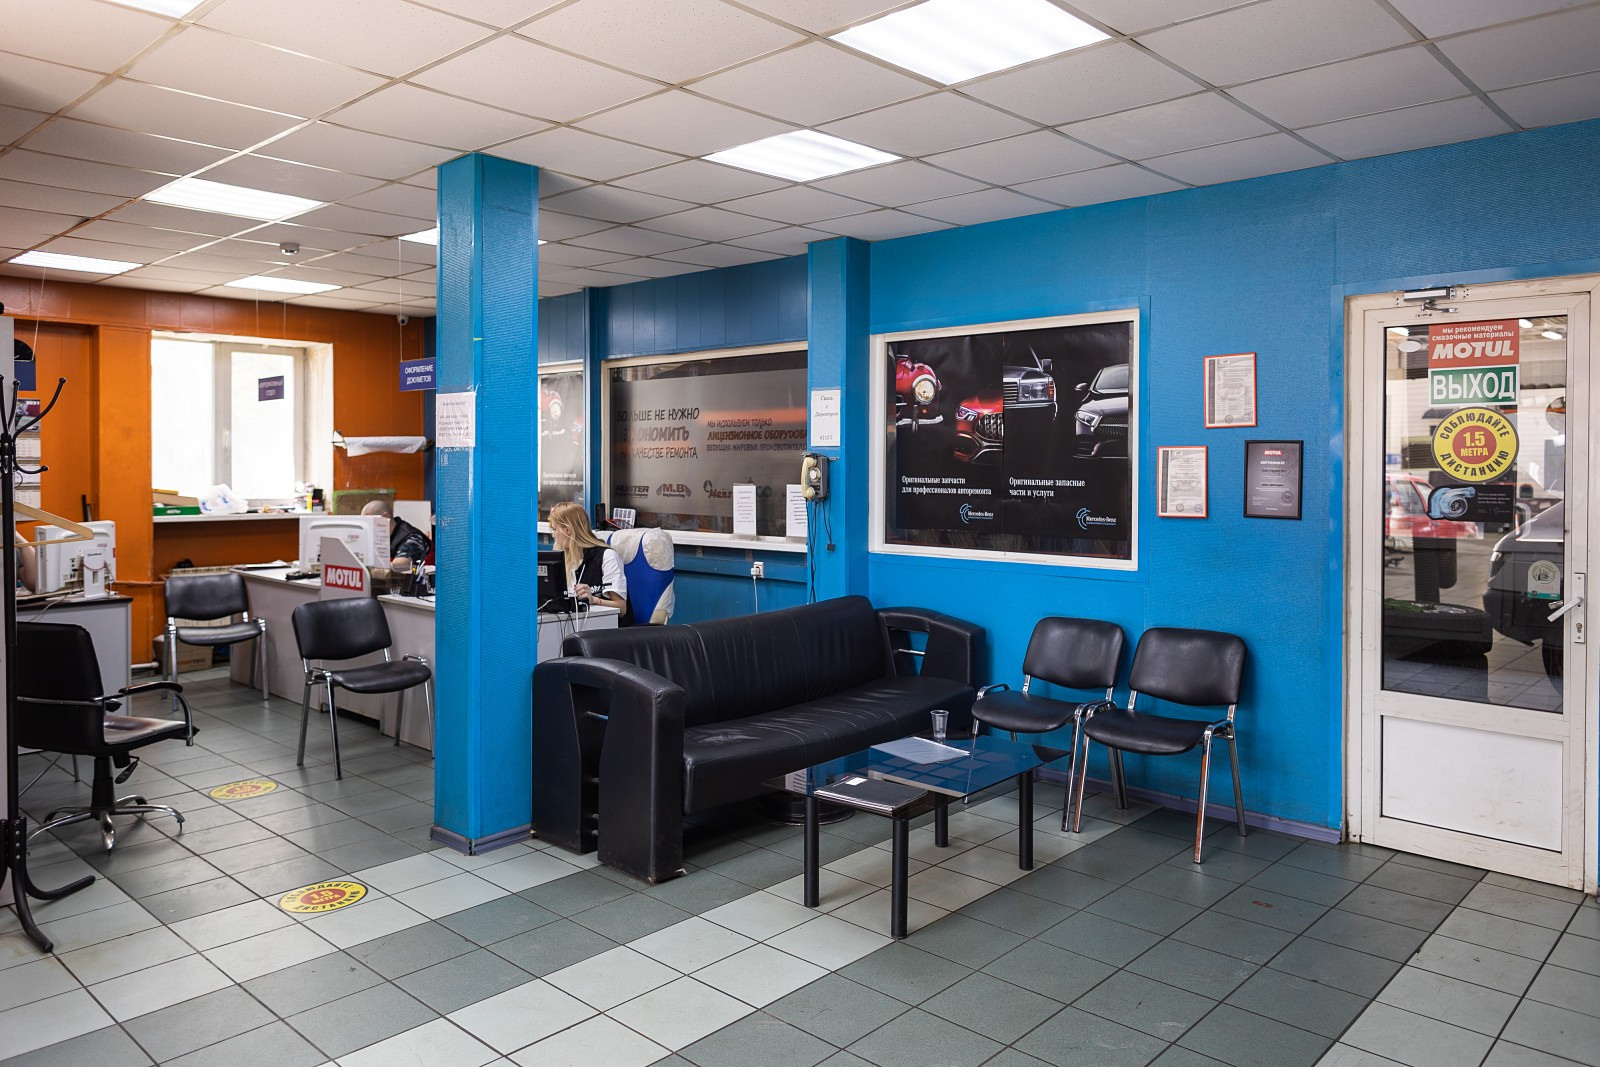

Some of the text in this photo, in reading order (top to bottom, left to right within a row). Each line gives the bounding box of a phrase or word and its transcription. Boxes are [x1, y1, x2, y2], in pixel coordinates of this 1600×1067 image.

[1455, 324, 1503, 334] рекомендуем
[1431, 331, 1514, 341] смазочные материалы
[1431, 340, 1515, 360] MOTUL
[1433, 371, 1515, 400] ВЫХОД
[655, 408, 666, 421] НЕ
[668, 407, 700, 421] НУЖНО
[716, 418, 750, 429] ИСПОЛЬЗУЕМ
[751, 418, 772, 429] ТОЛЬКО
[1440, 412, 1510, 440] СОБЛЮДАЙТЕ
[707, 430, 763, 442] ЛИЦЕНЗИОННОЕ
[1463, 431, 1486, 447] 1.5
[665, 446, 698, 459] РЕМОНТА
[1460, 447, 1488, 457] МЕТРА
[1440, 450, 1509, 477] ДИСТАНЦИЮ
[901, 475, 965, 485] Оригинальные запчасти
[1009, 476, 1085, 487] Оригинальные запасные
[912, 486, 957, 495] профессионалов
[957, 487, 992, 496] авторемонта
[1009, 488, 1026, 496] части
[1033, 489, 1054, 498] услуги
[326, 567, 362, 588] MOTUL
